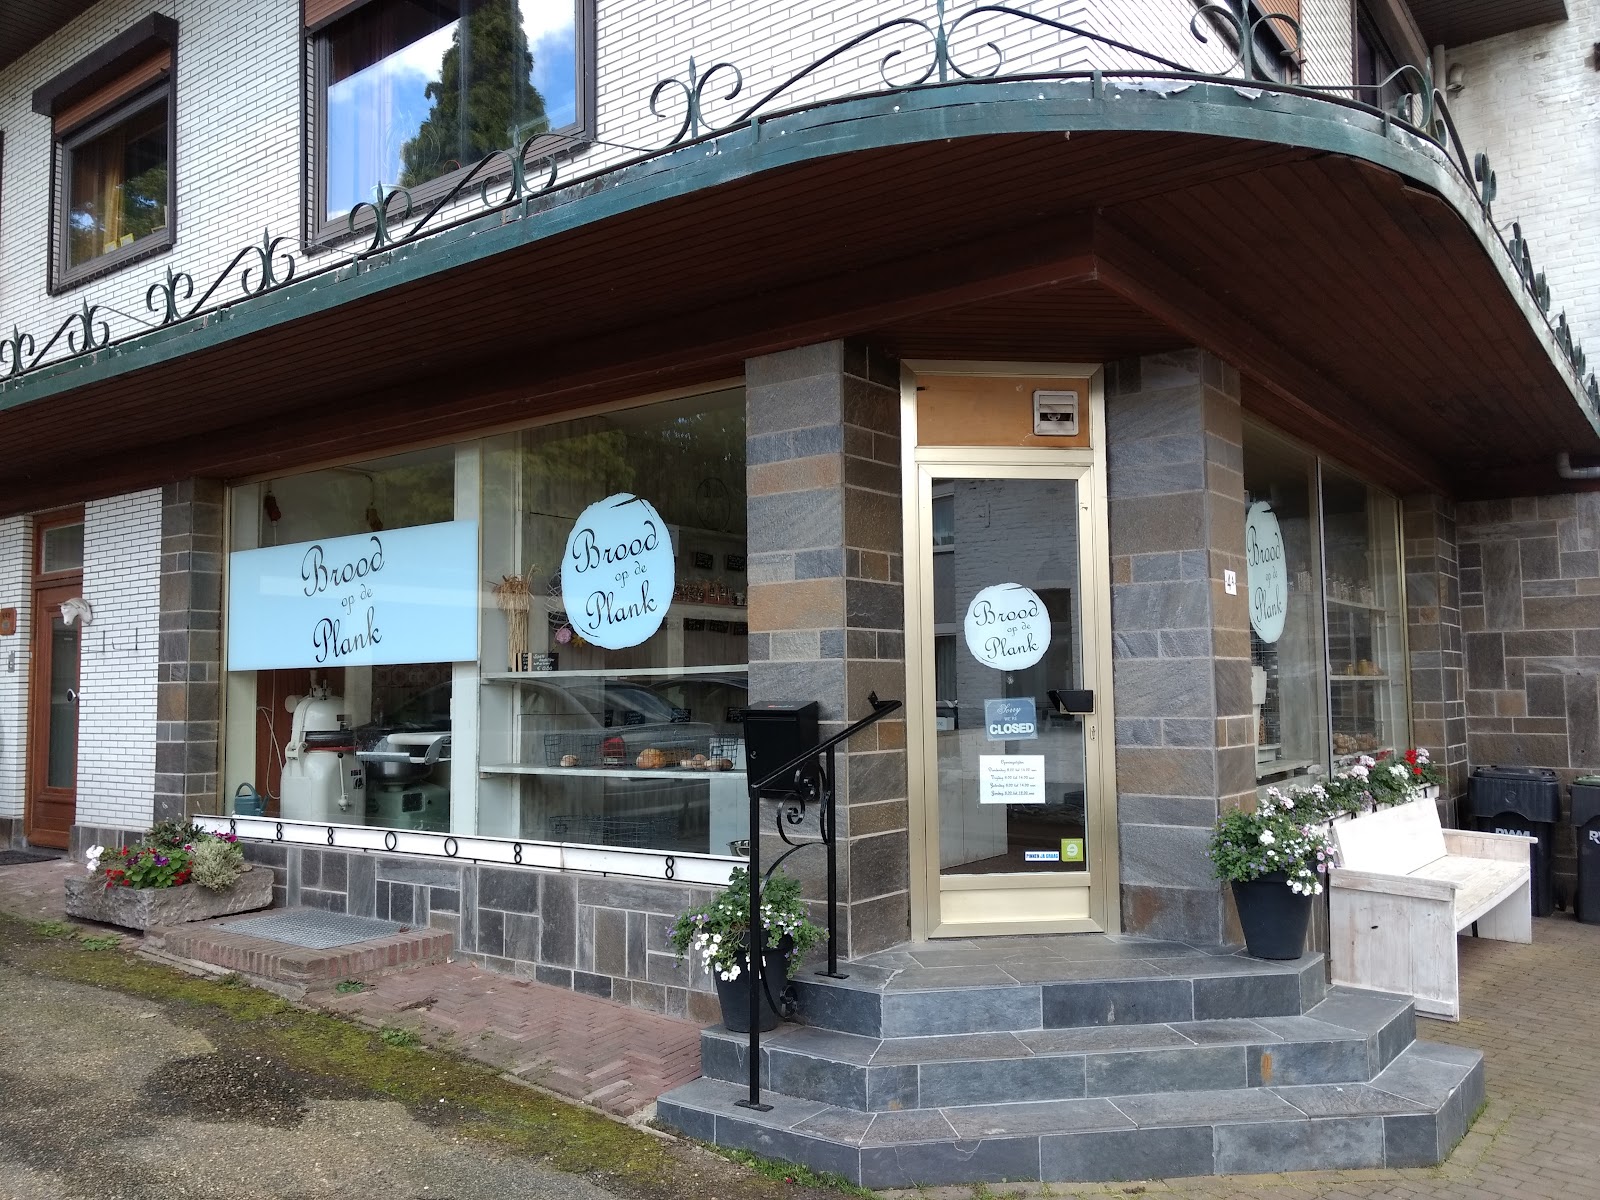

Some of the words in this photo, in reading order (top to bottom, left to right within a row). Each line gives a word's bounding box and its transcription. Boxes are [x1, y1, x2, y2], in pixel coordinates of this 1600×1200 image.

[572, 520, 659, 573] Brood
[1247, 525, 1281, 567] Brood
[301, 535, 385, 597] Brood
[614, 570, 629, 588] op
[634, 560, 647, 575] de
[1265, 573, 1272, 588] op
[1272, 565, 1278, 578] de
[341, 595, 355, 615] op
[360, 583, 374, 600] de
[585, 579, 658, 630] Plank
[973, 599, 1040, 626] Brood
[1254, 584, 1282, 623] Plank
[313, 605, 383, 663] Plank
[1006, 626, 1018, 637] op
[1021, 621, 1031, 630] de
[985, 632, 1039, 660] Plank
[997, 703, 1021, 716] Sorry
[989, 722, 1035, 735] CLOSED
